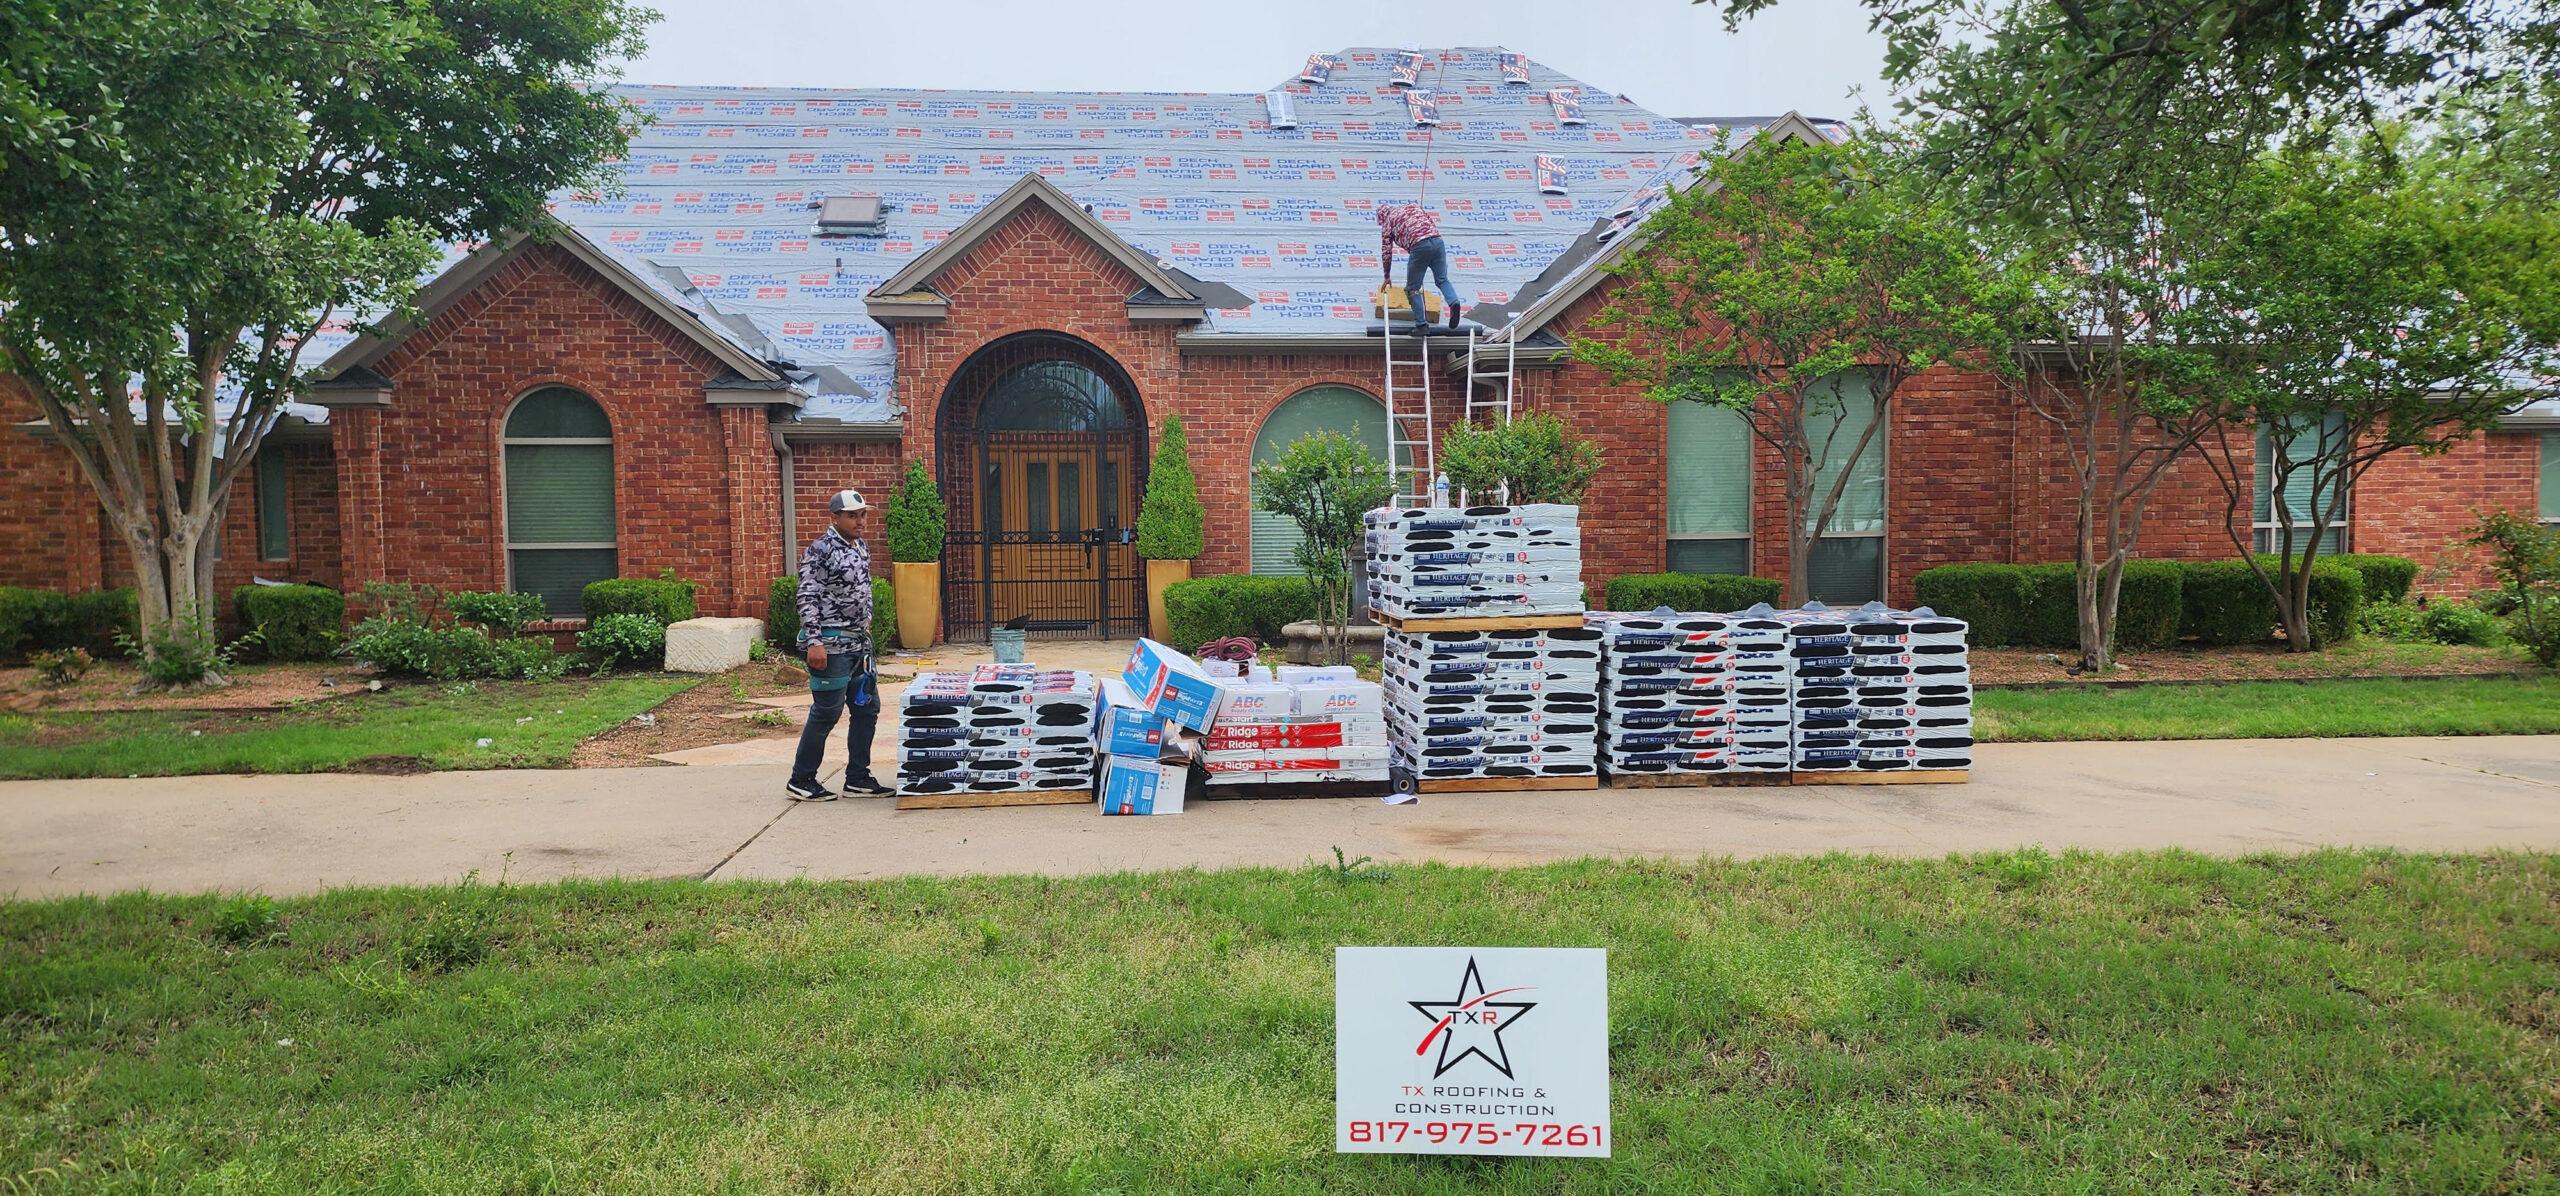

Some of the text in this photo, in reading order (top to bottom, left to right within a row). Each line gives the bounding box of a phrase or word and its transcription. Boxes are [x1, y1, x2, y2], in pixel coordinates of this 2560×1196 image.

[1818, 657, 1854, 665] HERITAGE
[1231, 696, 1265, 708] ABC
[1324, 694, 1358, 707] ABC
[1227, 726, 1259, 739] Ridge
[1224, 761, 1256, 771] Ridge
[1447, 1010, 1498, 1025] TXR
[1401, 1085, 1547, 1098] TX ROOFING &
[1395, 1103, 1554, 1116] CONSTRUCTION
[1349, 1121, 1602, 1147] 817-975-7261
